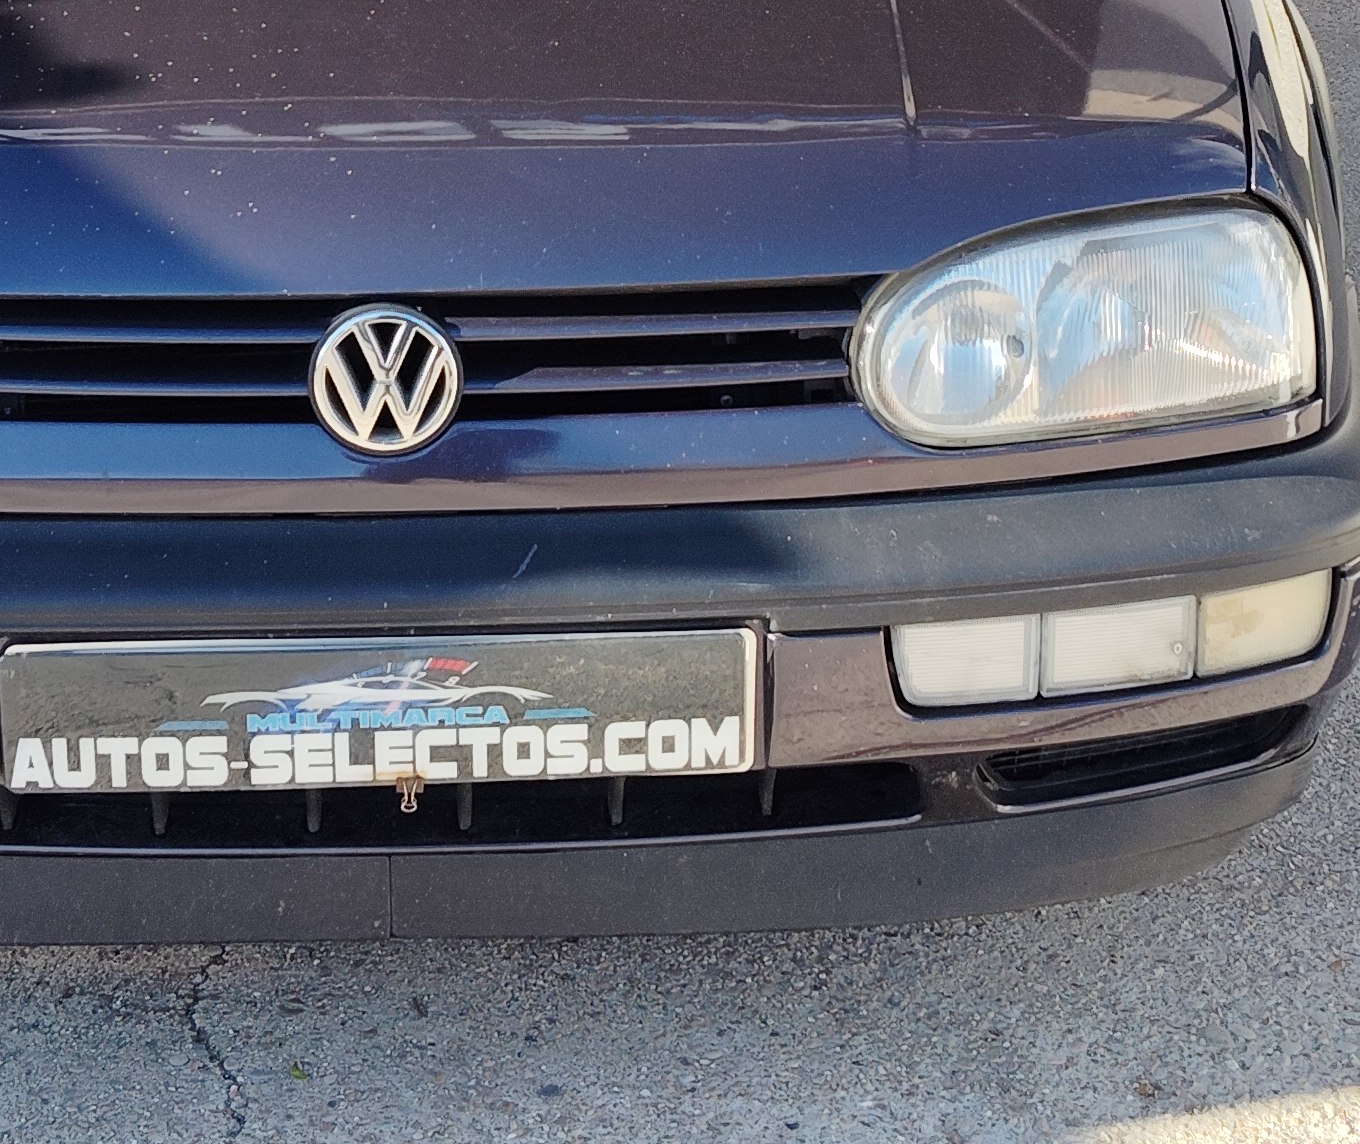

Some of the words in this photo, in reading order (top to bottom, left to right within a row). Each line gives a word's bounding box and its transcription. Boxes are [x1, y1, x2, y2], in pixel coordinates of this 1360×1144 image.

[314, 312, 458, 451] VW
[11, 715, 741, 790] AUTOS-SELECTOS.COM
[246, 705, 509, 733] MULTIMARCA
